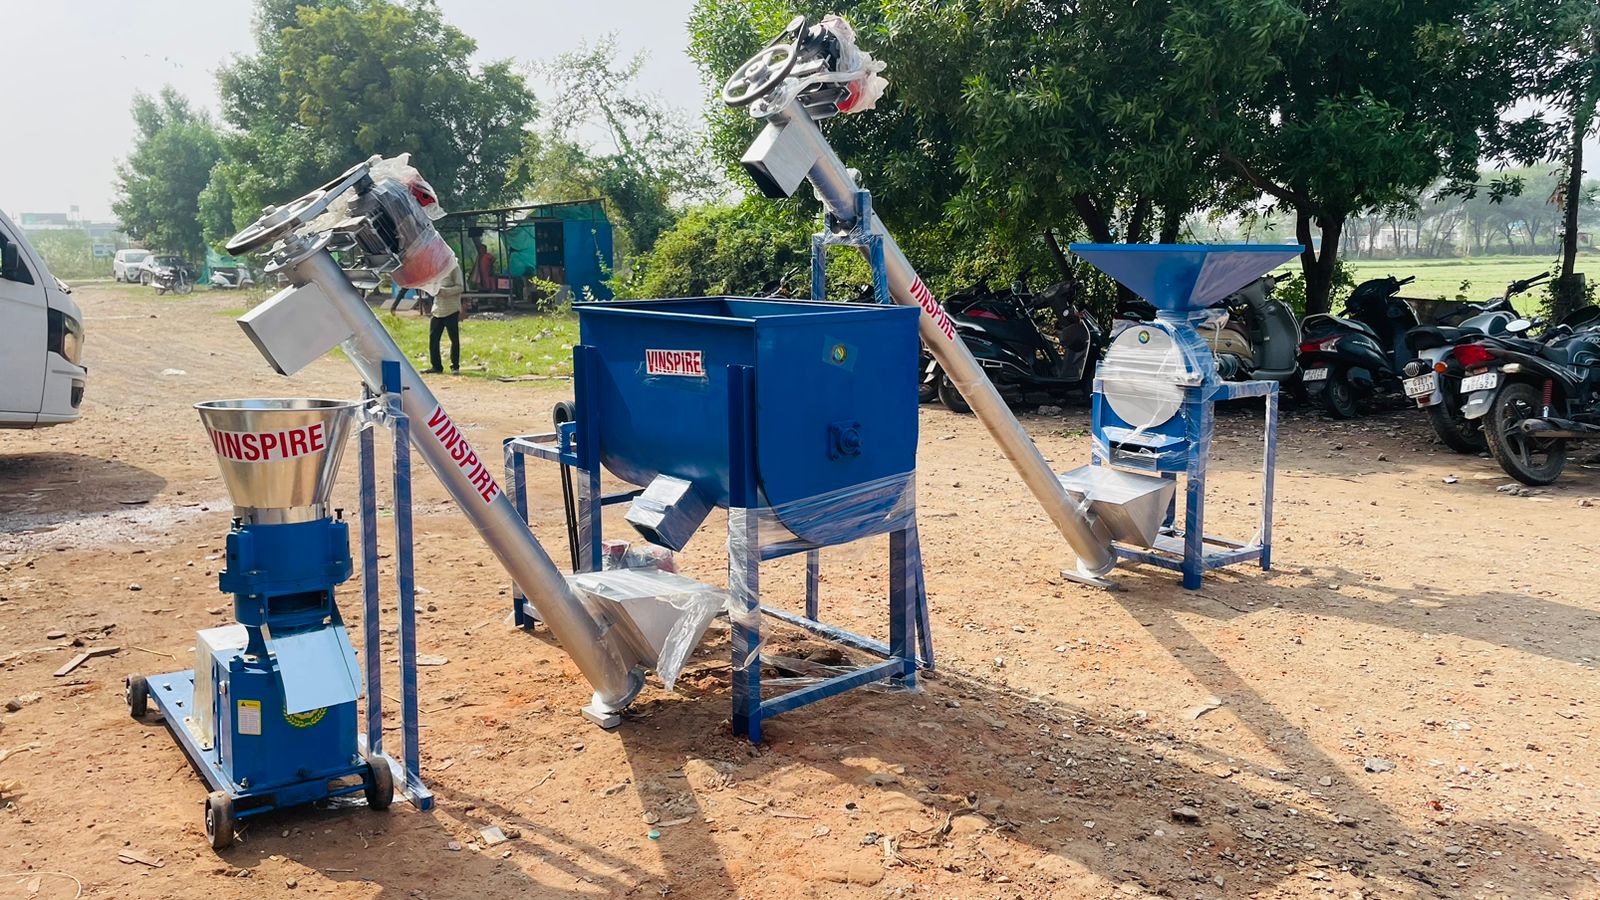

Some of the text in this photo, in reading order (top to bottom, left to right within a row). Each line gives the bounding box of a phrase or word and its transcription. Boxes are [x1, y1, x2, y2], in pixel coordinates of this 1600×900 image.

[909, 276, 955, 341] VINSPIRE
[647, 351, 701, 373] VINSPIRE
[207, 424, 324, 461] VINSPIRE
[427, 406, 500, 503] VINSPIRE
